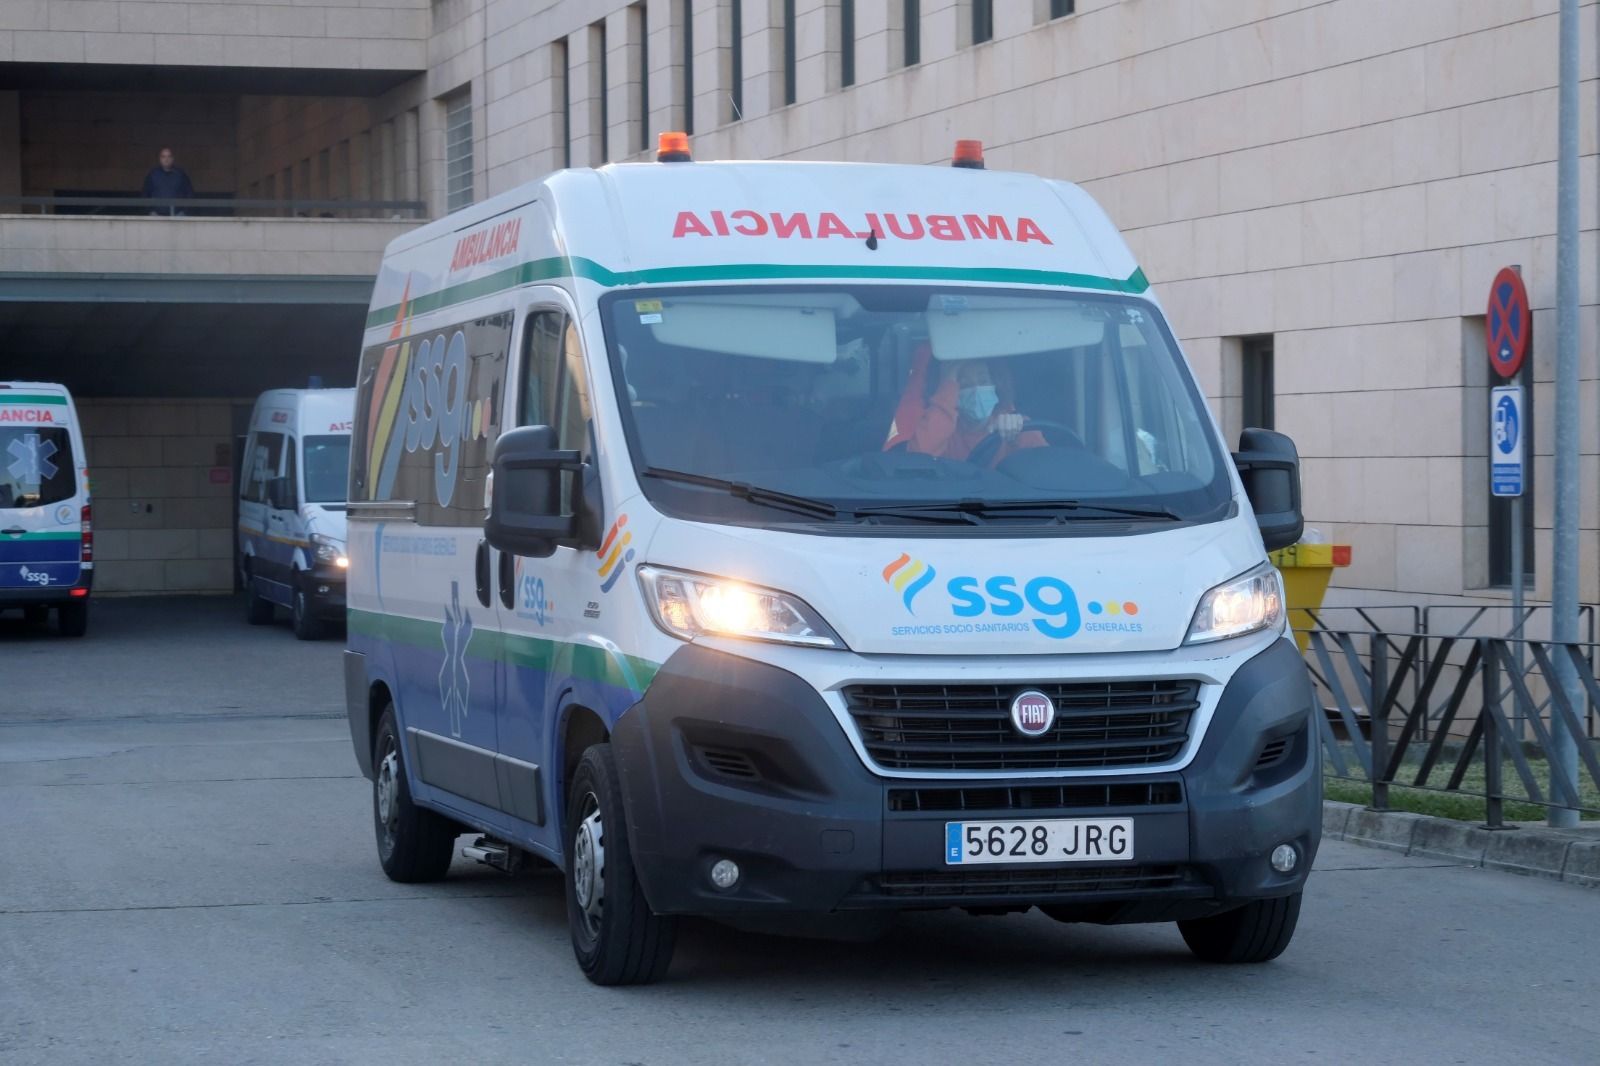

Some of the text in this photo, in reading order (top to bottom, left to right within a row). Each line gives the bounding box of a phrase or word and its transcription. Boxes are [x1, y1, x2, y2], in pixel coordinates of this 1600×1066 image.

[449, 217, 522, 273] AMBULANCIA
[0, 409, 54, 422] ANCIA
[27, 572, 49, 585] ssg
[947, 576, 1082, 639] ssg
[892, 622, 1143, 636] SERVICIOS SOCIO SANITARIOS GENERALES
[1022, 704, 1046, 724] FIAT
[966, 825, 1127, 857] 5628 JRG
[951, 847, 959, 857] E
